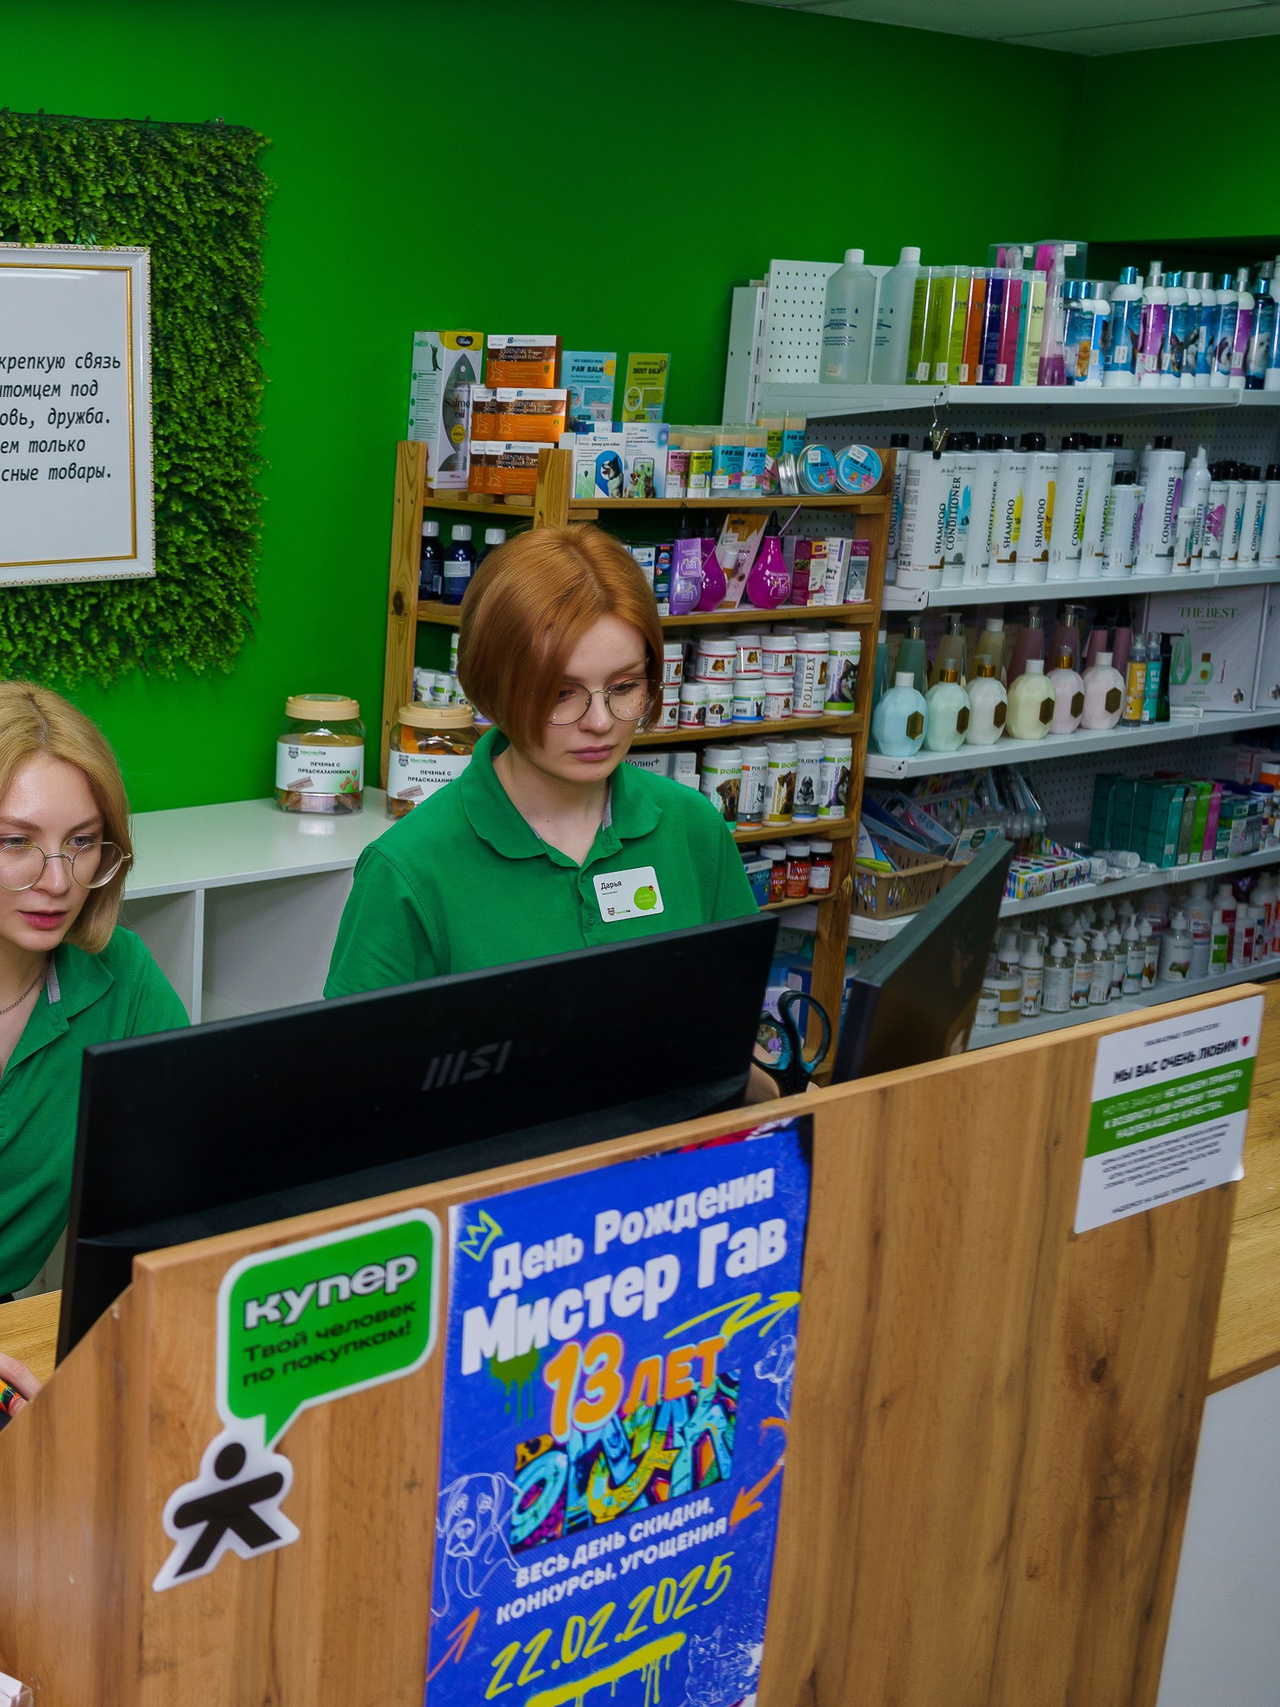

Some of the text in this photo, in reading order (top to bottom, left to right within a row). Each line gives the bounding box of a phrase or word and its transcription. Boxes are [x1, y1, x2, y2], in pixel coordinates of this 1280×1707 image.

[75, 351, 121, 369] связь
[587, 365, 604, 373] BALM
[70, 379, 99, 397] под
[47, 406, 110, 430] дружба.
[28, 439, 86, 453] только
[48, 462, 111, 484] товары.
[934, 502, 947, 555] SHAMPOO
[946, 477, 962, 551] CONDITIONER
[986, 481, 998, 554] CONDITIONER
[1002, 498, 1016, 549] SHAMPOO
[1034, 498, 1047, 548] SHAMPOO
[1071, 476, 1086, 547] CONDITIONER
[1161, 475, 1176, 544] CONDITIONER
[1179, 606, 1238, 619] THE BEST
[802, 656, 816, 709] POLIDEX
[600, 880, 622, 891] Дарья
[421, 1040, 512, 1092] MSI
[1112, 1037, 1240, 1084] МЫ ВАС ОЧЕНЬ ЛЮБИМ
[488, 1167, 776, 1299] День Рождения
[244, 1254, 419, 1331] купер
[461, 1218, 788, 1376] Мистер Гав
[242, 1319, 413, 1388] по покупкам!
[243, 1300, 417, 1364] Твой человек
[542, 1331, 728, 1442] 13 ЛЕТ
[496, 1516, 728, 1626] КОНКУРСЫ, УГОЩЕНИЯ
[515, 1553, 571, 1589] ВЕСЬ
[570, 1531, 627, 1571] ДЕНЬ
[484, 1551, 736, 1700] 22.02.2025
